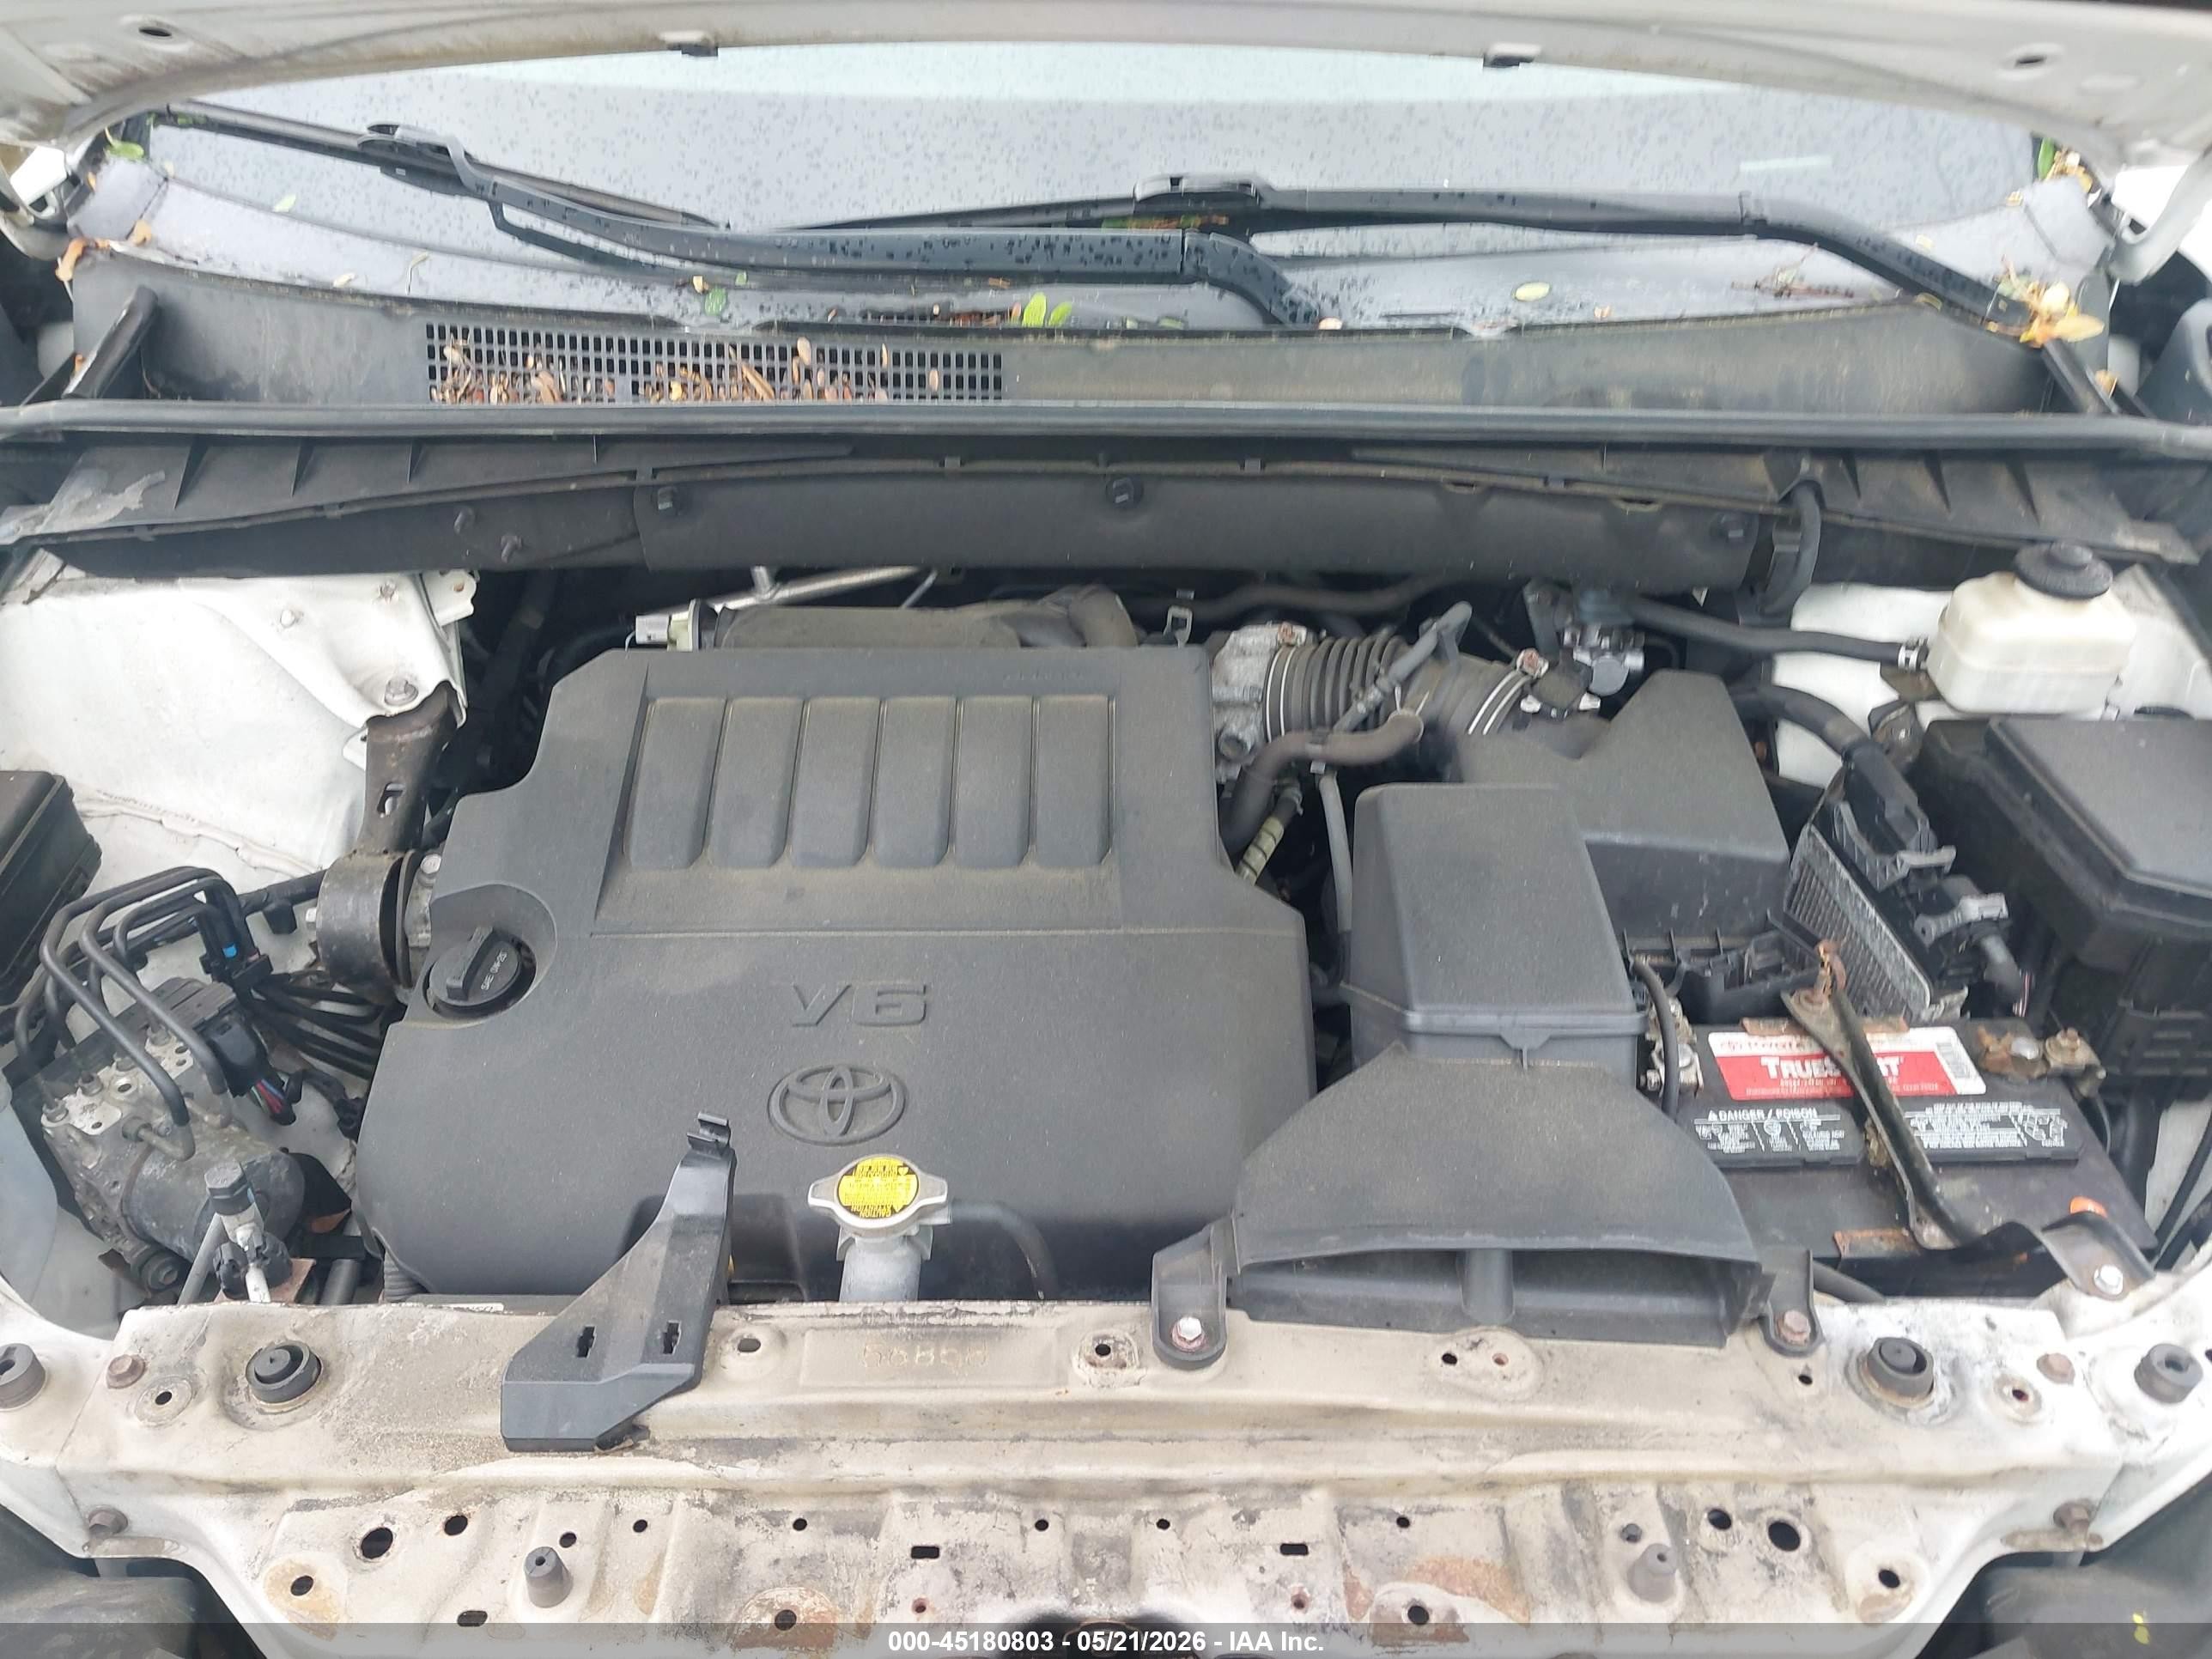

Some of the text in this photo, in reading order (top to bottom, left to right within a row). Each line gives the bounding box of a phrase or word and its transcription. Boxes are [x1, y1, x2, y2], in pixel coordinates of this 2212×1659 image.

[789, 982, 927, 1028] V6
[1718, 1109, 1765, 1121] DANGER
[1775, 1107, 1818, 1120] POISON
